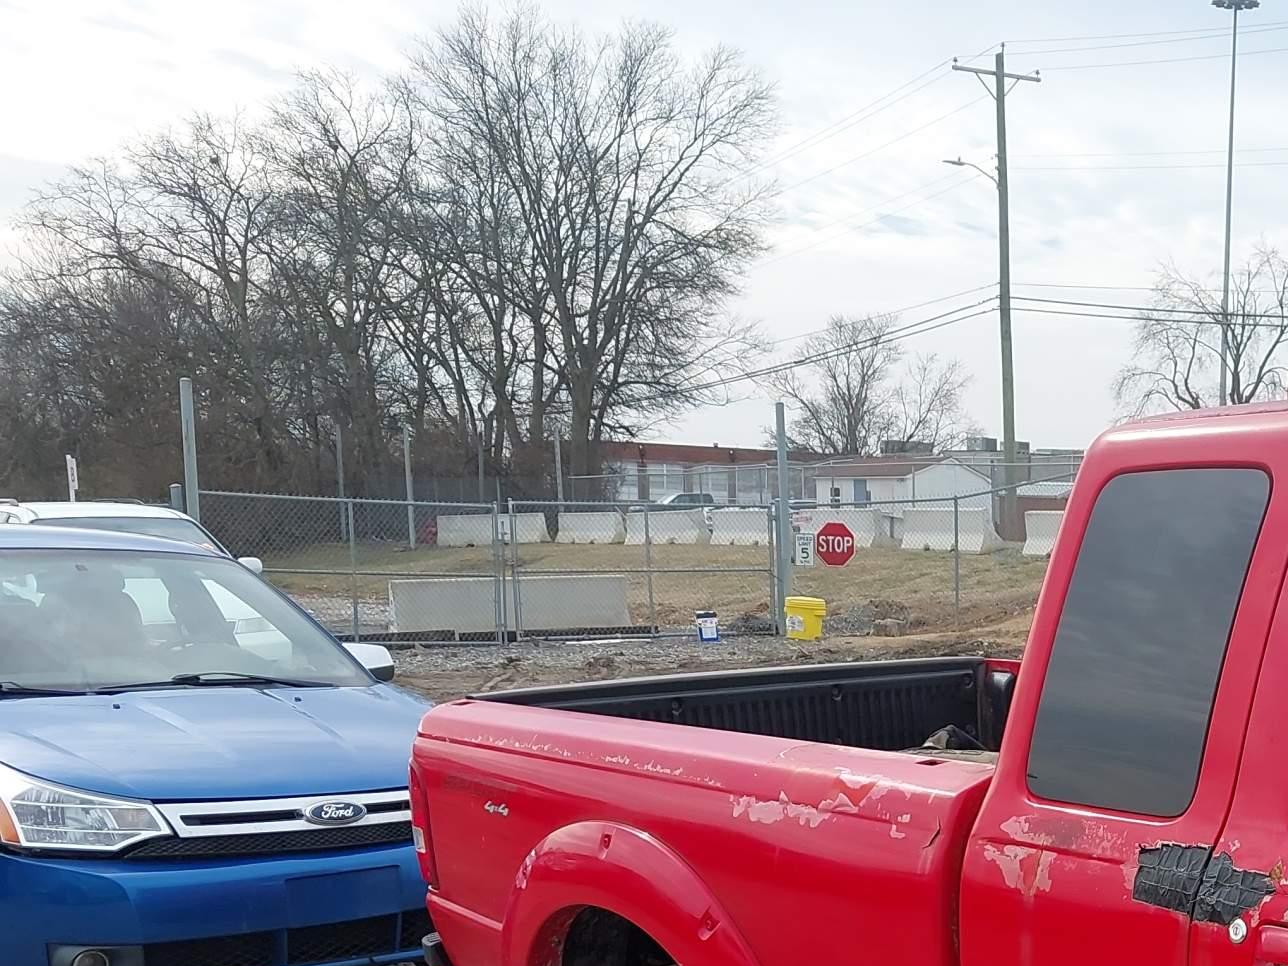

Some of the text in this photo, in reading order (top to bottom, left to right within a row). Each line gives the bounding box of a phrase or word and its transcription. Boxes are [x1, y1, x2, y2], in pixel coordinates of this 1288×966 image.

[818, 535, 853, 553] STOP
[801, 547, 810, 559] 5
[321, 803, 354, 819] Ford
